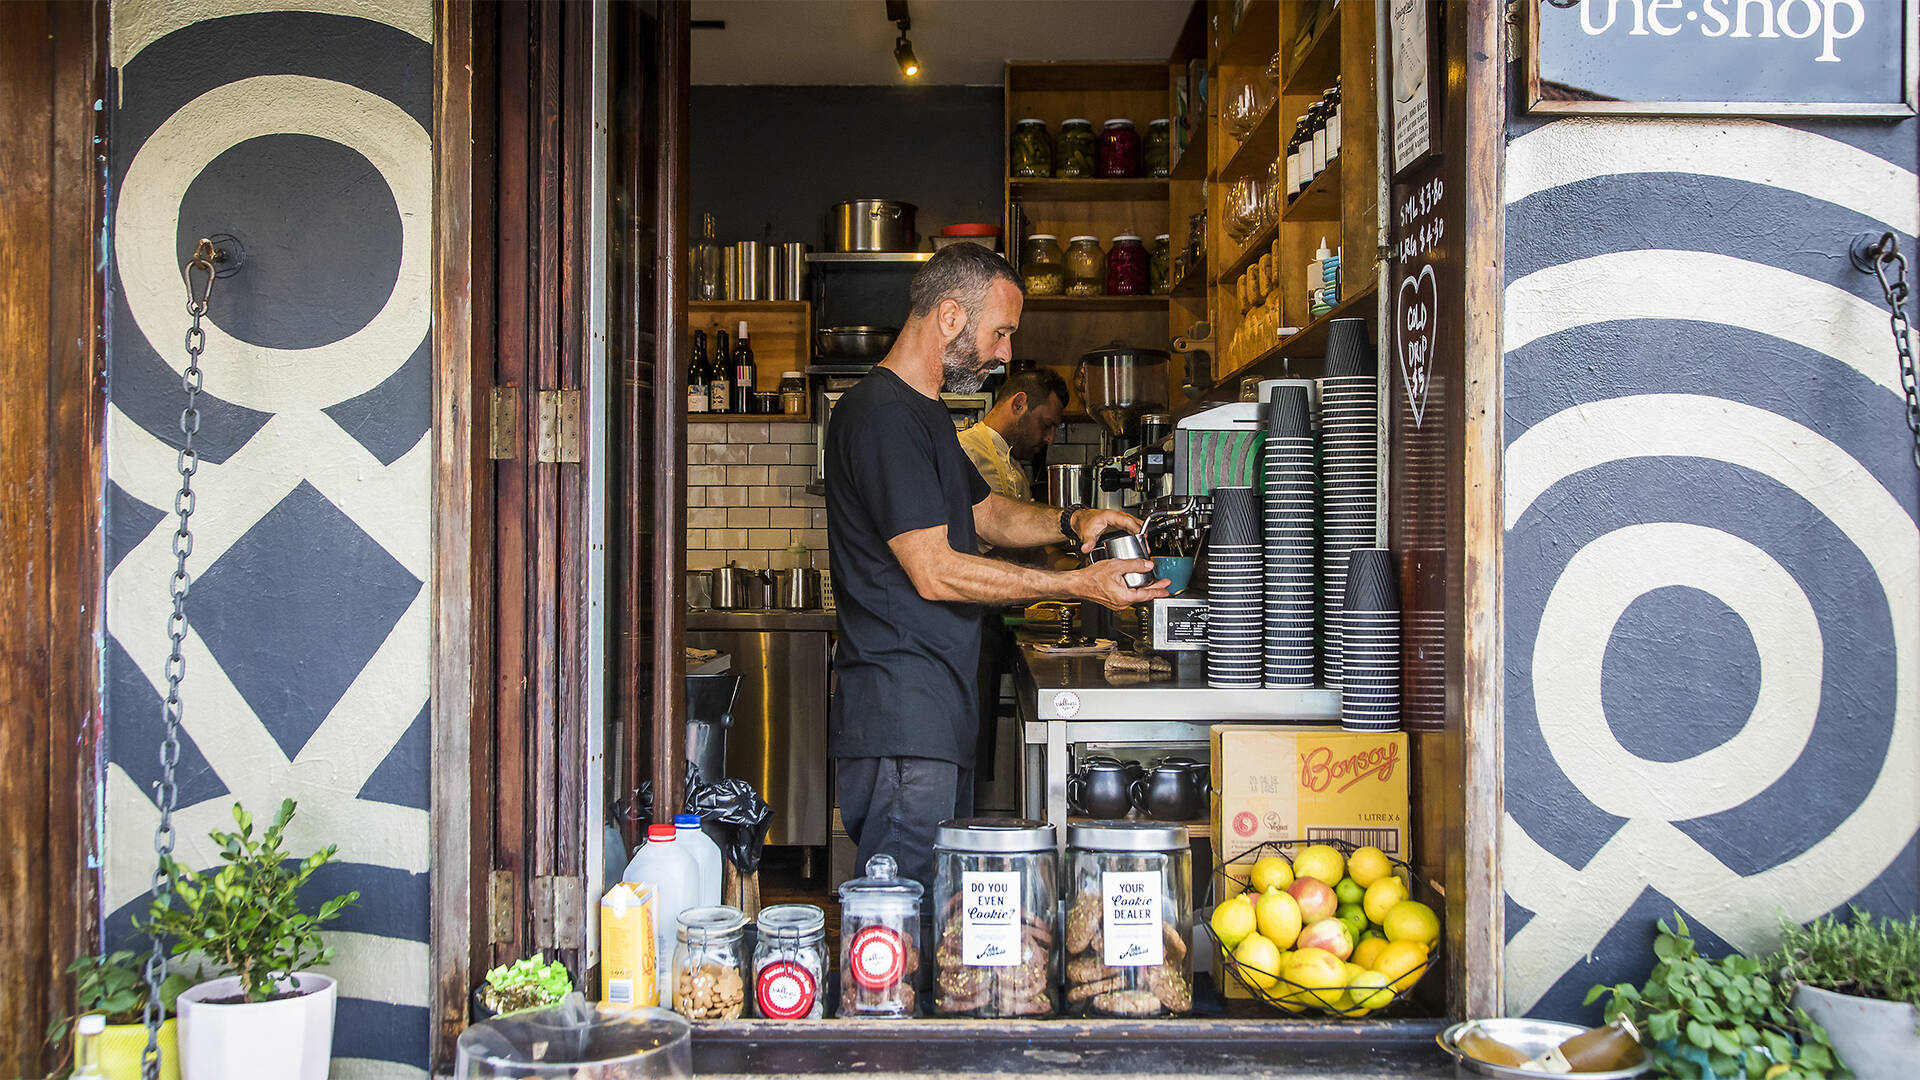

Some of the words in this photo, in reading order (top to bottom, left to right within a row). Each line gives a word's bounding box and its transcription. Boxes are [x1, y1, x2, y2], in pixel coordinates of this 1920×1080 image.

[1400, 195, 1419, 227] SML
[1407, 302, 1427, 331] COLD
[1412, 366, 1425, 398] $5
[1301, 742, 1400, 793] Bonsoy
[971, 883, 985, 893] DO
[988, 883, 1008, 893] YOU
[1119, 884, 1145, 893] YOUR
[978, 896, 1004, 906] EVEN
[1111, 894, 1152, 907] Cookie
[967, 907, 1016, 919] Cookie?
[1114, 909, 1151, 919] DEALER
